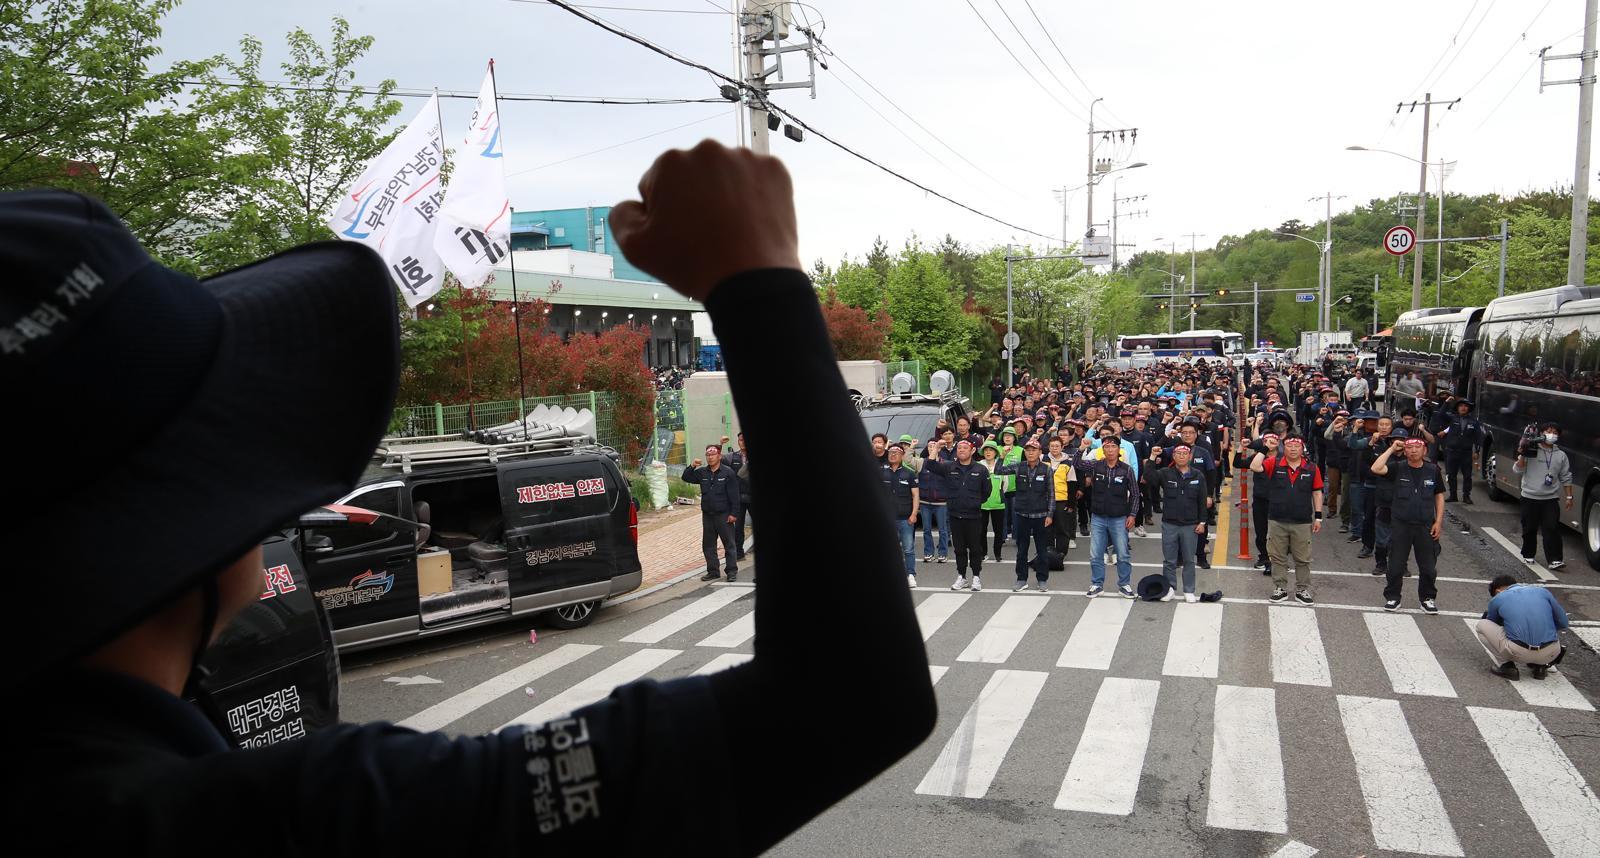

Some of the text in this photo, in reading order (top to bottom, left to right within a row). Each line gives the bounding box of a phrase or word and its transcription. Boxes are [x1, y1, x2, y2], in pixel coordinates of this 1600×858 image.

[1391, 233, 1408, 248] 50
[517, 477, 606, 504] 제한없는 안전
[525, 541, 597, 566] 경남지역본부
[227, 685, 301, 735] 대구경북
